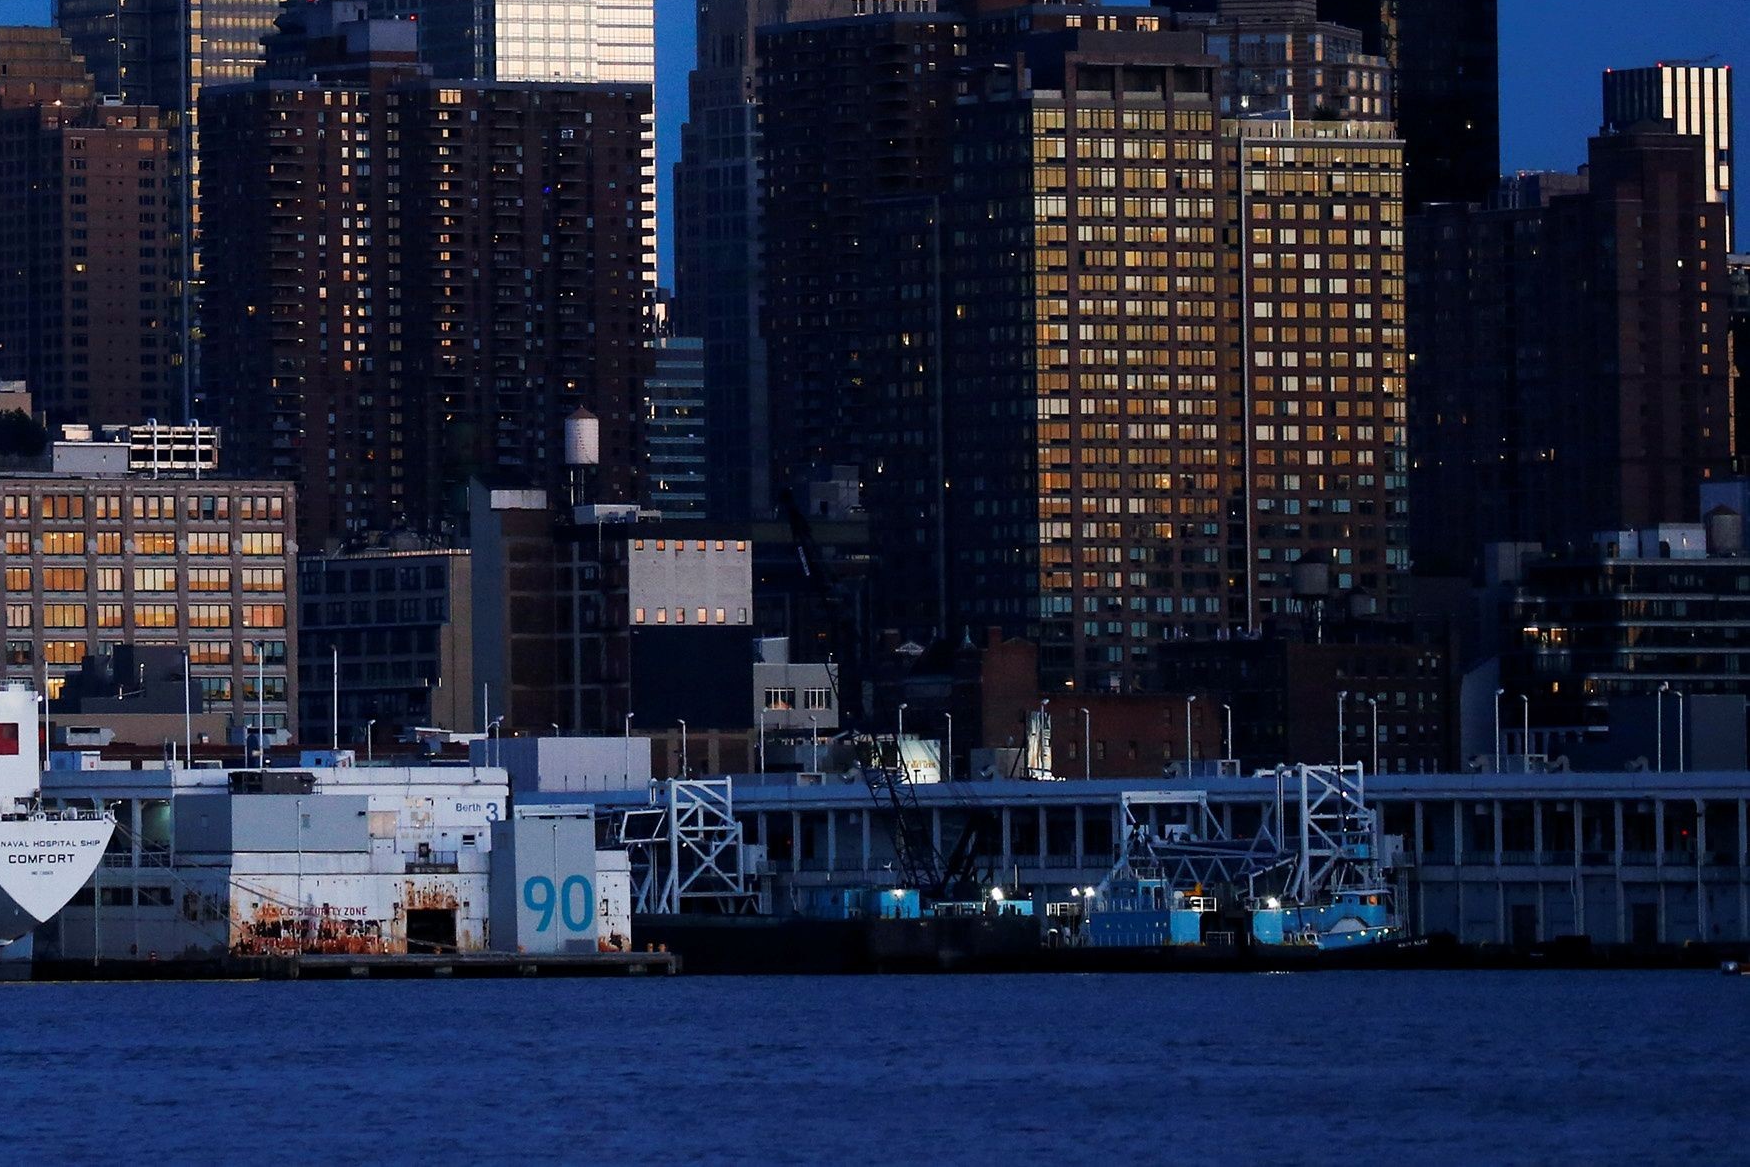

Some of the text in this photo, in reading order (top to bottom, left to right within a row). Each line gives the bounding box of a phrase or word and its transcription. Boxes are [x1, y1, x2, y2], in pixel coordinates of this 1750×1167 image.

[455, 802, 499, 823] Berth 3
[0, 840, 30, 848] NAVAL
[80, 839, 101, 847] SHIP
[8, 853, 75, 864] COMFORT
[524, 875, 593, 932] 90
[344, 906, 368, 916] ZONE
